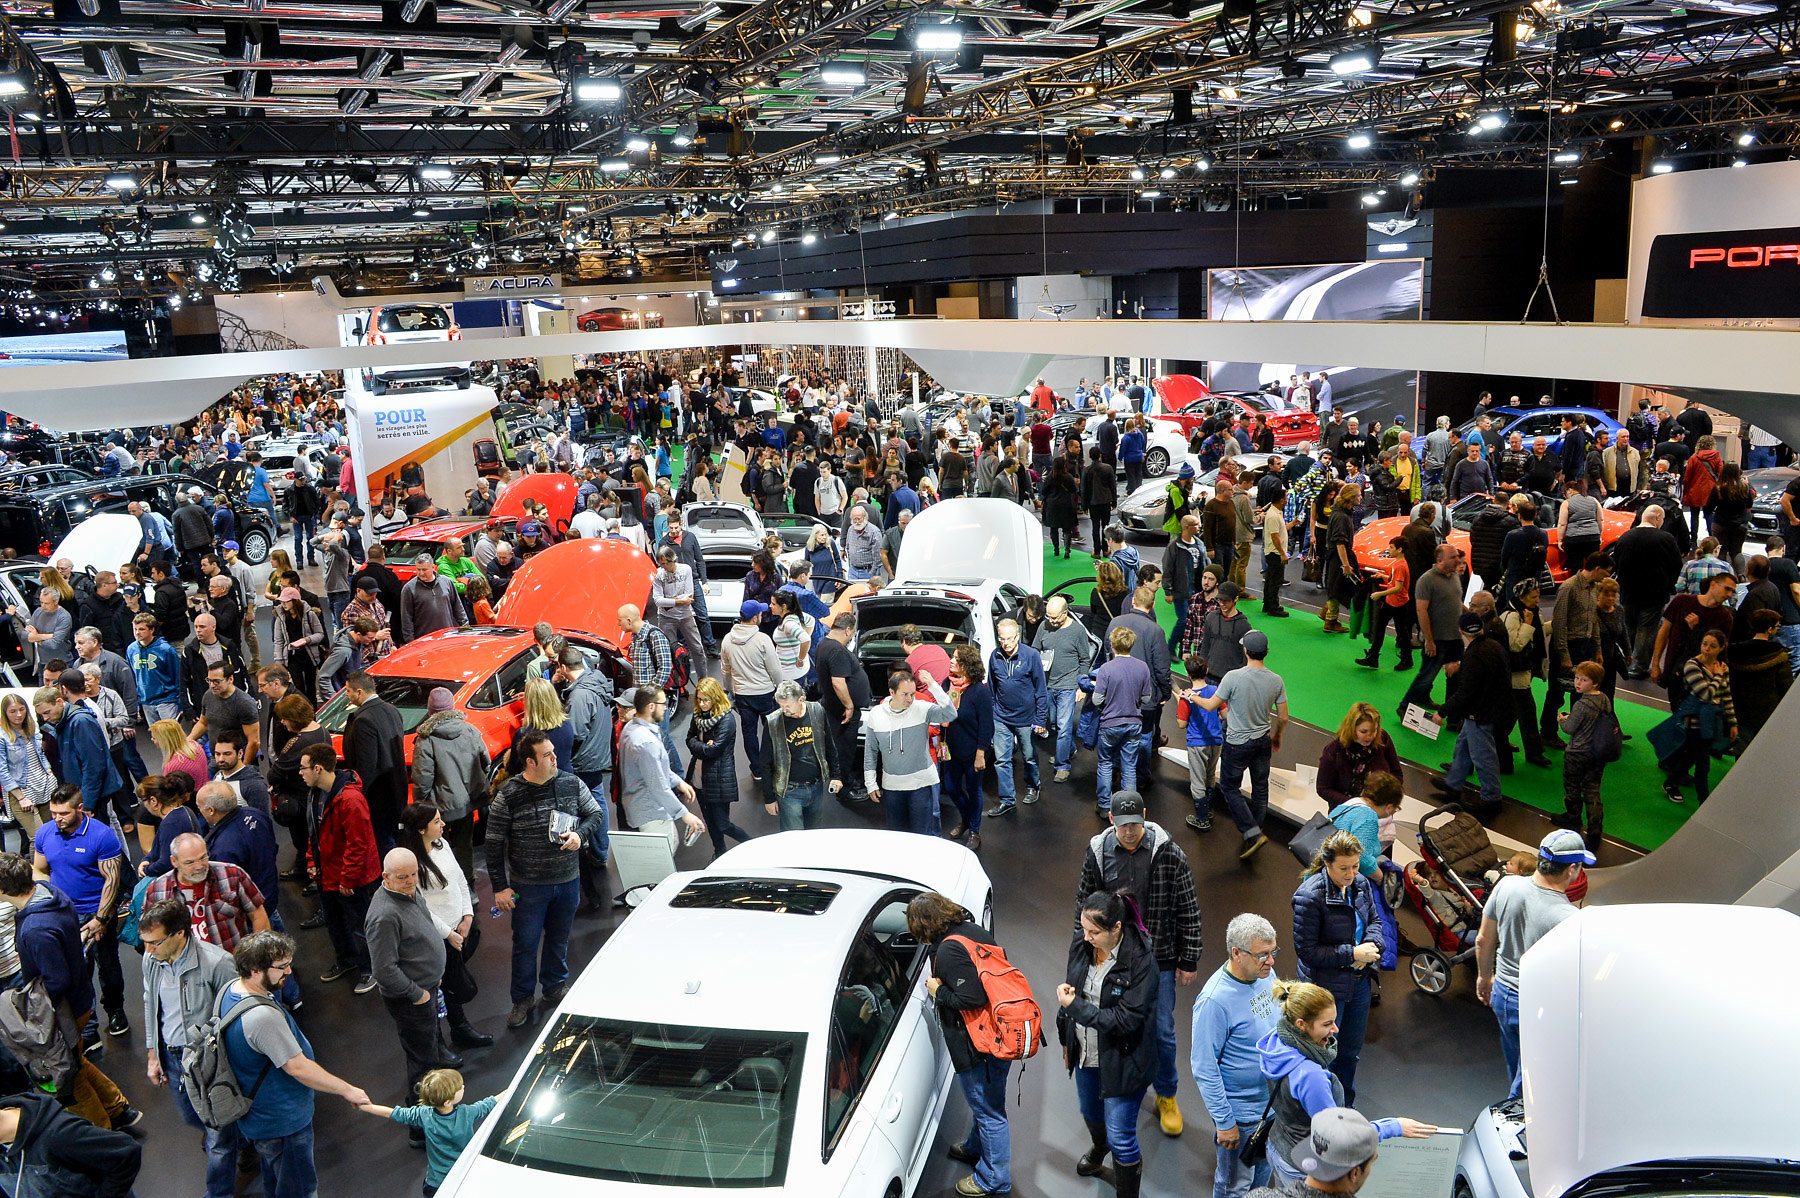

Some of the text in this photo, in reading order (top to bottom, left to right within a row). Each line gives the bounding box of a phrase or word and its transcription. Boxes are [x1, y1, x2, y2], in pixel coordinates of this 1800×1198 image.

[1689, 244, 1800, 269] POR
[488, 276, 554, 290] ACURA
[374, 408, 427, 426] POUR
[377, 430, 401, 440] serrés
